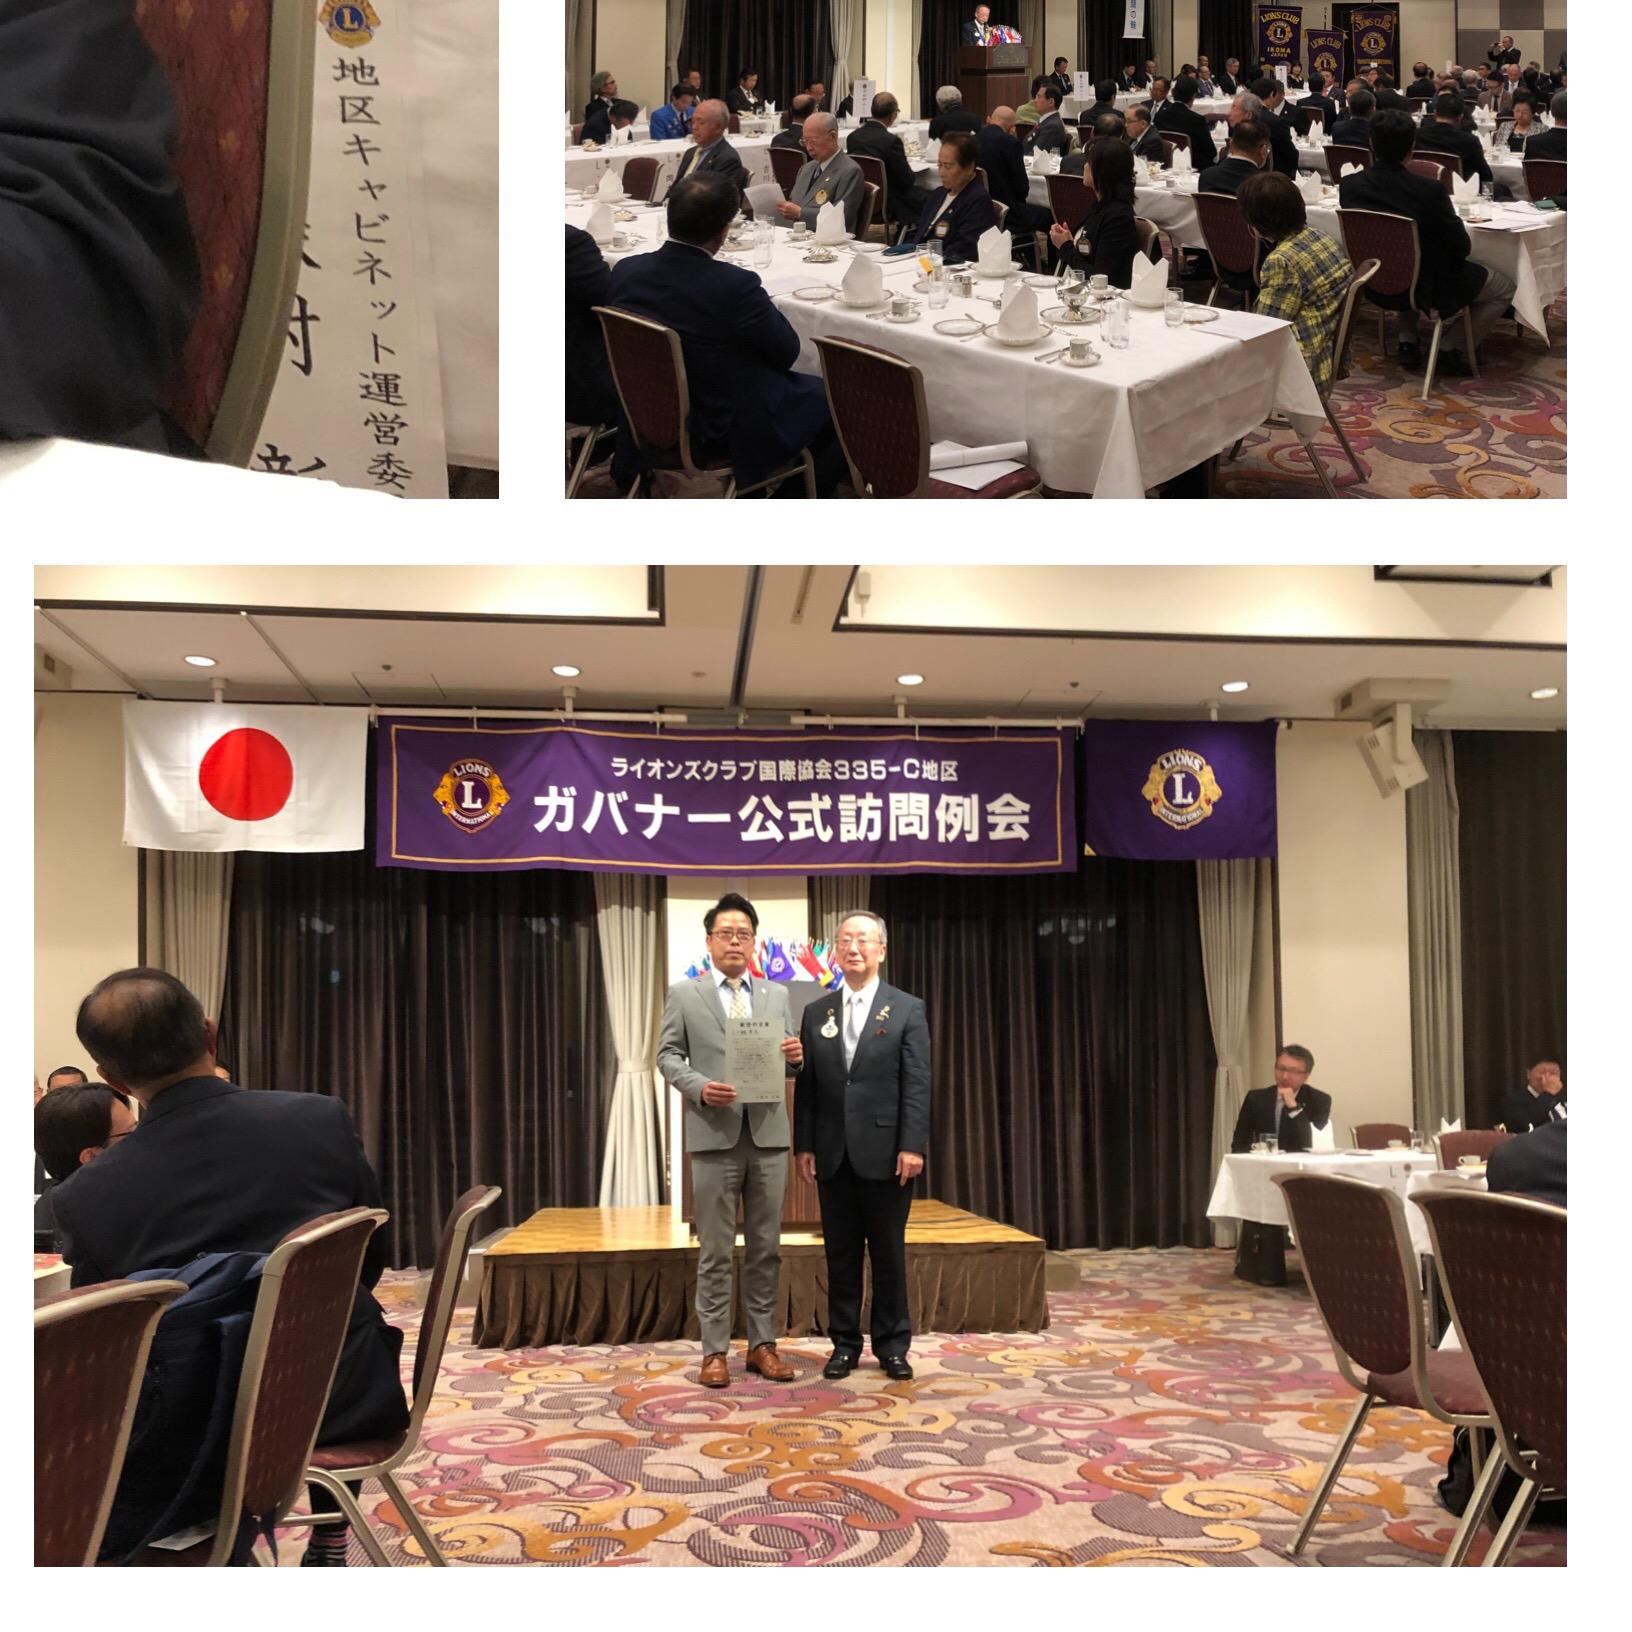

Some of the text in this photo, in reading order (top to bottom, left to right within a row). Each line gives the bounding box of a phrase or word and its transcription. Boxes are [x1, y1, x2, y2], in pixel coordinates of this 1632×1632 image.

[343, 8, 358, 29] L
[332, 56, 412, 499] 地区キャビネット運営委
[453, 763, 491, 777] LIONS
[1162, 753, 1203, 771] LIONS
[461, 781, 483, 809] L
[1172, 773, 1194, 804] L
[533, 785, 1031, 842] ガバナー公式訪問例会
